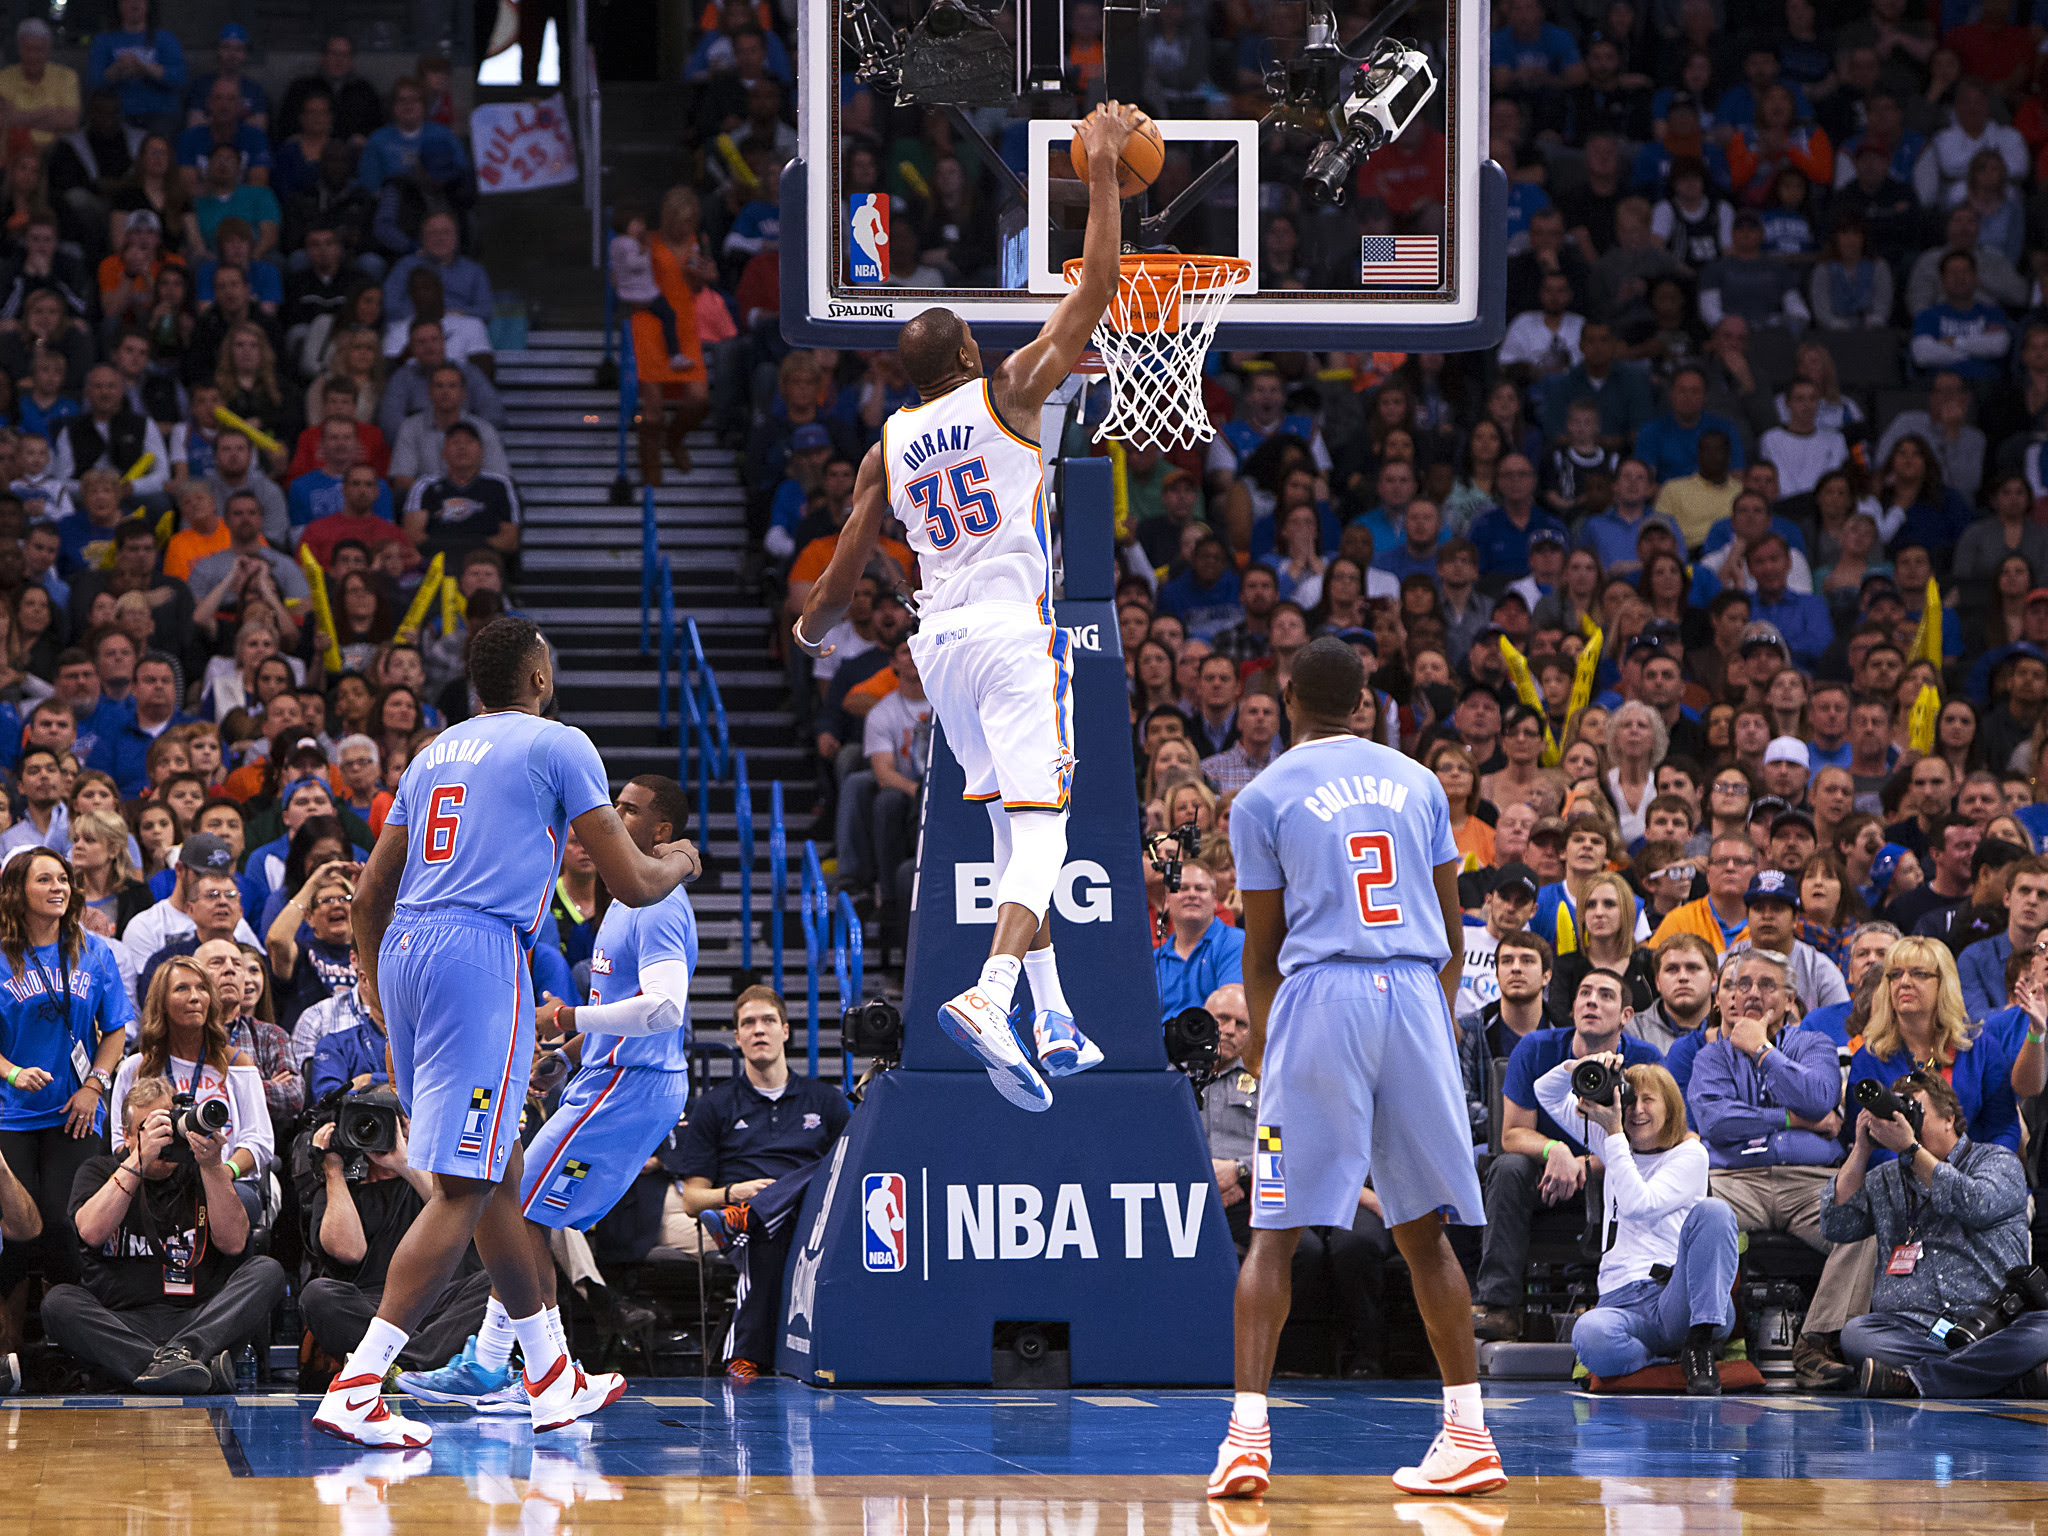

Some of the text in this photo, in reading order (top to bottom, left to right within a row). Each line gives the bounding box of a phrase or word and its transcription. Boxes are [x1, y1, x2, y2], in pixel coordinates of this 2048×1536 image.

[854, 264, 878, 277] NBA
[828, 303, 894, 319] SPALDING
[903, 425, 974, 471] DURANT
[904, 456, 1002, 551] 35
[426, 738, 493, 770] JORDAN
[1304, 775, 1409, 822] COLLISON
[423, 782, 467, 865] 6
[955, 859, 1113, 924] BG
[1346, 830, 1404, 927] 2
[198, 1205, 206, 1227] EOS
[947, 1182, 1209, 1260] NBA TV
[869, 1251, 893, 1265] NBA
